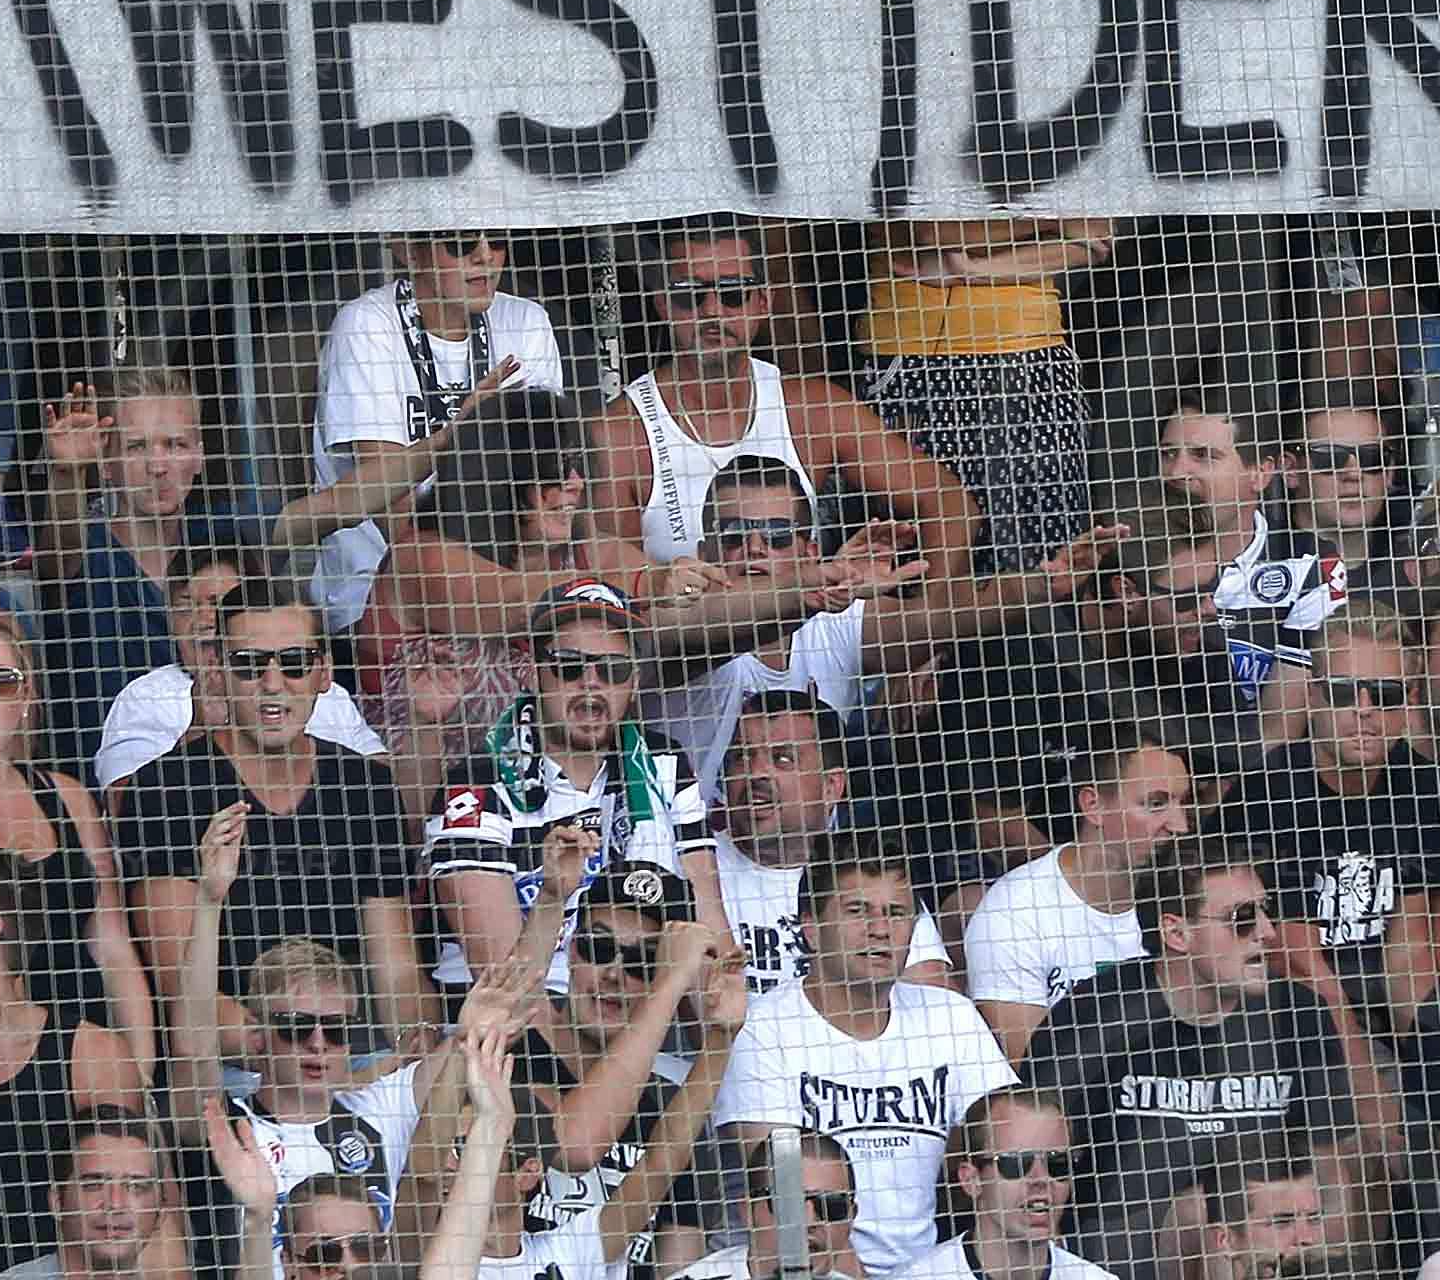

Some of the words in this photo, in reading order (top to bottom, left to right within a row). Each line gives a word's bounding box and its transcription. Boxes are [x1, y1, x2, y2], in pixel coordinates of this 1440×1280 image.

[801, 1066, 949, 1131] STURM
[1120, 1074, 1214, 1113] STURM
[1219, 1071, 1293, 1109] GRAZ
